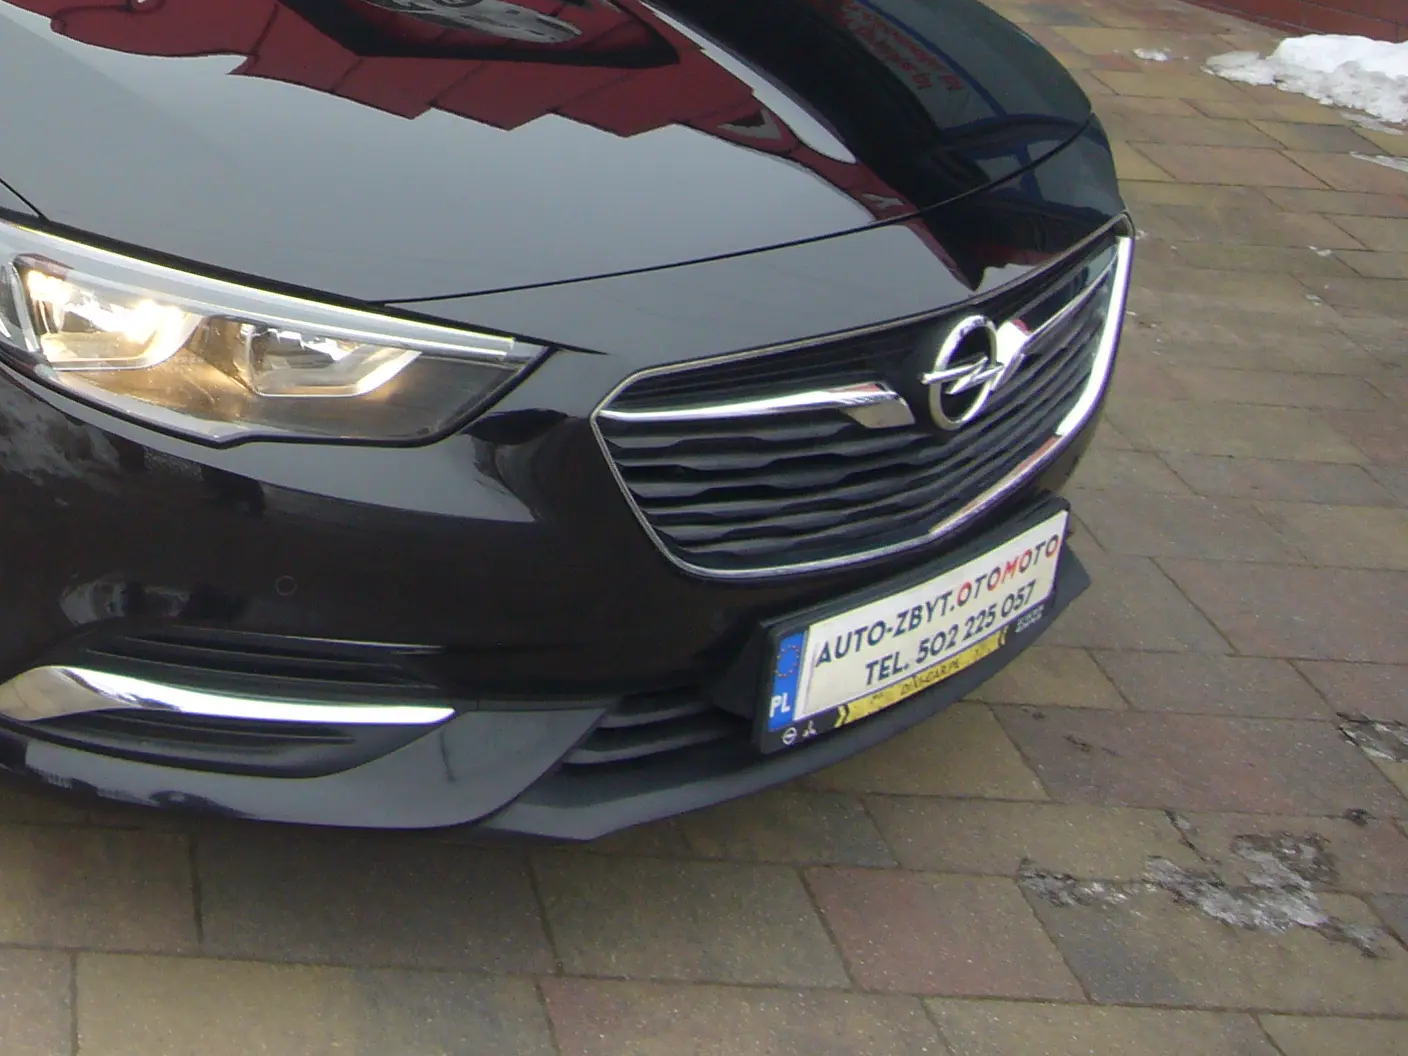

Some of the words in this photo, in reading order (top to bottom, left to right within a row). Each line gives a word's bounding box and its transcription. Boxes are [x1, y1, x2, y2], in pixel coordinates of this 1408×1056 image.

[814, 532, 1060, 669] AUTO-ZBYT.OTOMOTO
[863, 652, 910, 687] TEL.
[915, 623, 960, 665] 502
[962, 602, 997, 642] 225
[1000, 578, 1037, 620] 057
[769, 691, 791, 718] PL
